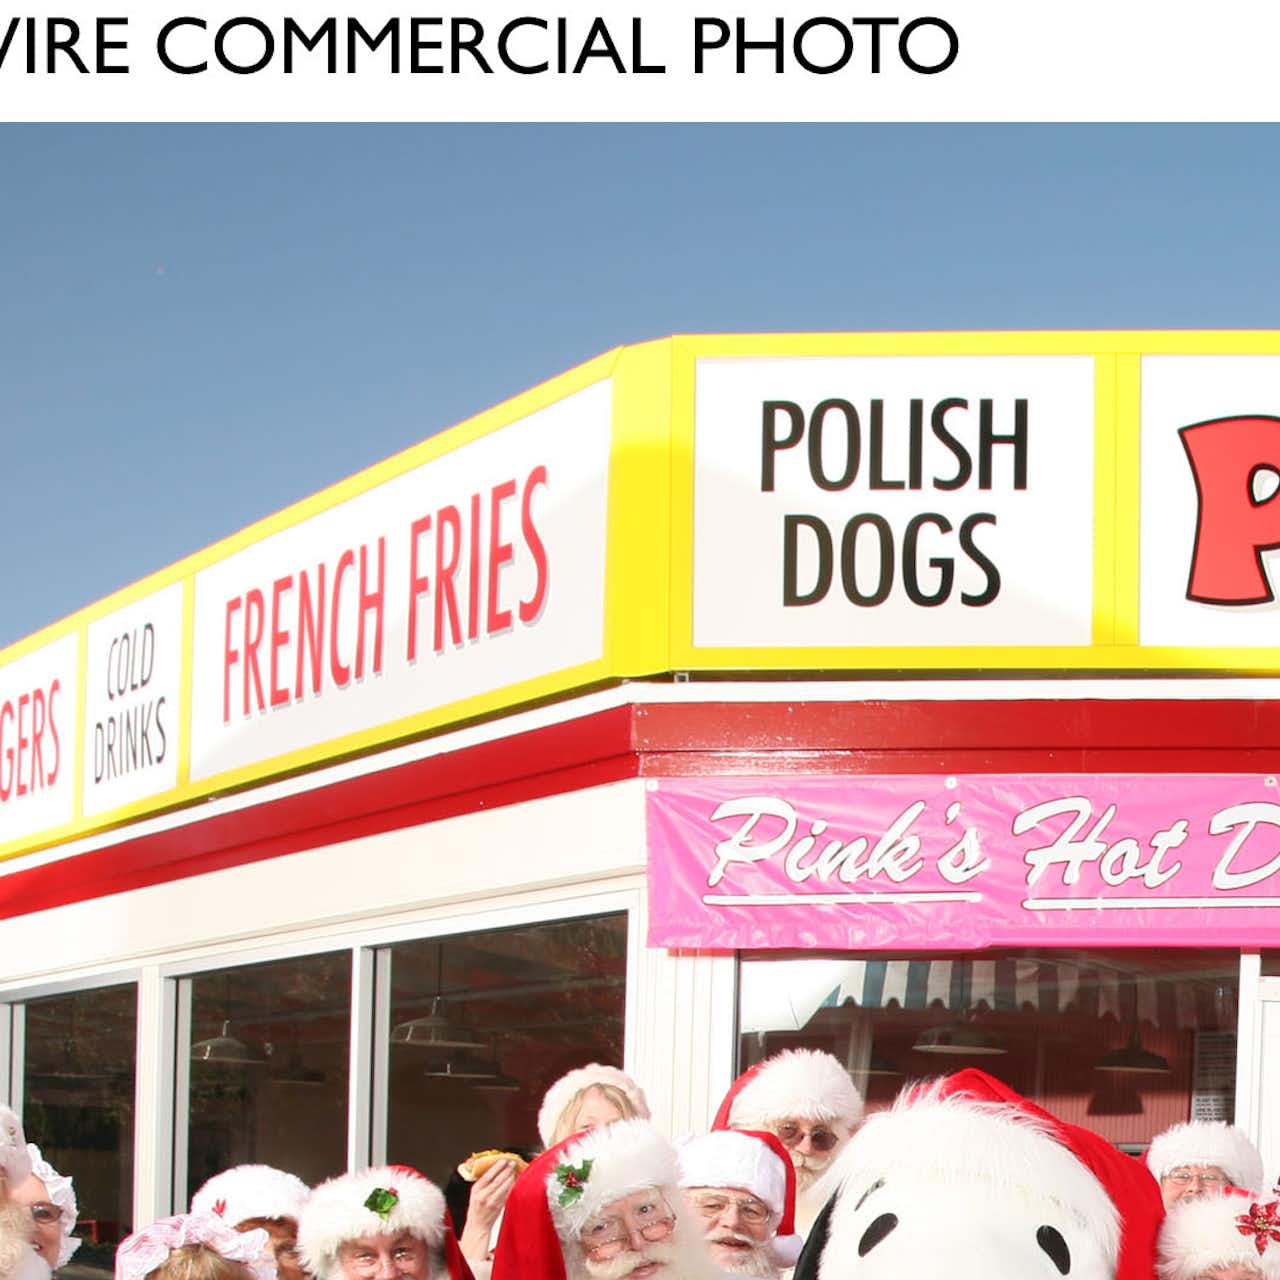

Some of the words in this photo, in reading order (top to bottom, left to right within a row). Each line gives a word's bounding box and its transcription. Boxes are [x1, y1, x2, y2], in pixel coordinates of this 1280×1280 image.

[761, 397, 1028, 492] POLISH
[223, 536, 387, 724] FRENCH
[407, 465, 549, 662] FRIES
[783, 512, 1001, 608] DOGS
[107, 622, 155, 700] COLD
[0, 678, 60, 803] GERS
[94, 696, 166, 784] DRINKS
[706, 797, 990, 887] Pink's
[1014, 797, 1188, 888] Hot
